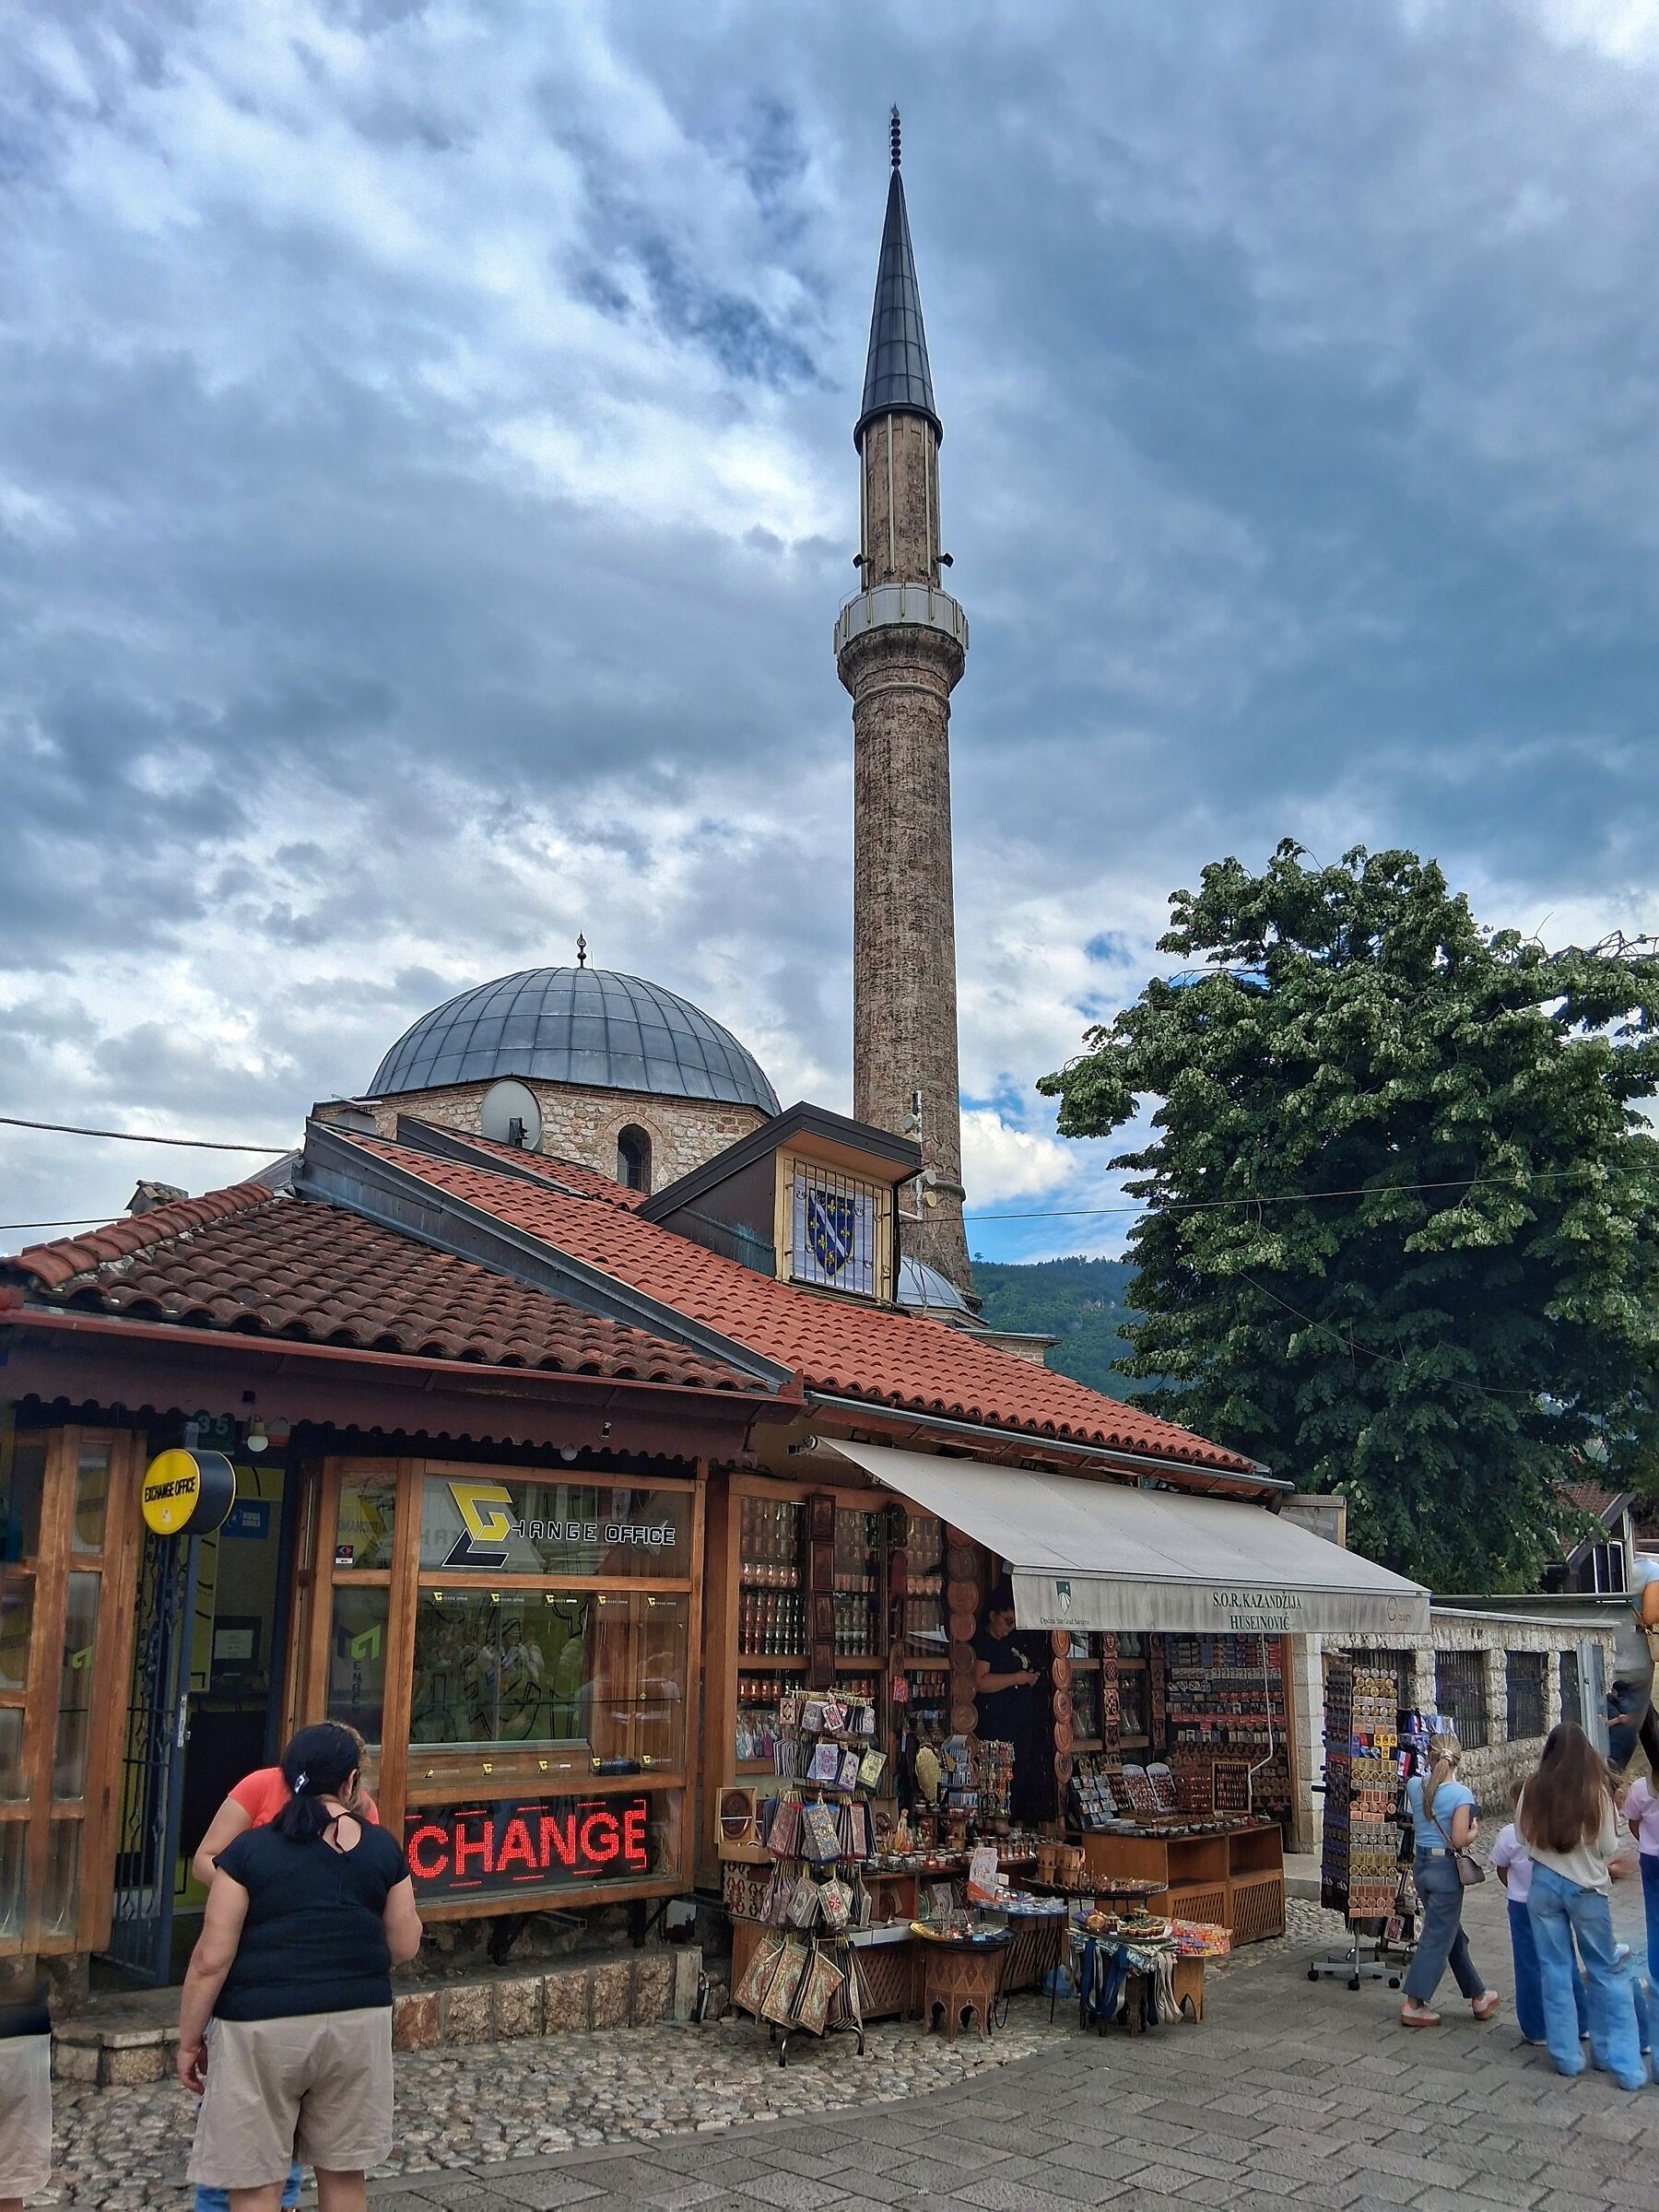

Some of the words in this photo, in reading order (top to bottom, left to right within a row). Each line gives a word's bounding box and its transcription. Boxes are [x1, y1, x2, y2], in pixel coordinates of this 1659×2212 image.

[197, 1415, 229, 1435] 35
[145, 1480, 174, 1502] EXCHANGE
[175, 1477, 196, 1496] OFFICE
[605, 1524, 676, 1546] OFFICE
[1242, 1591, 1302, 1609] KAZANDŽIJA
[1230, 1612, 1290, 1630] HUSEINOVIĆ
[408, 1810, 646, 1877] CHANGE
